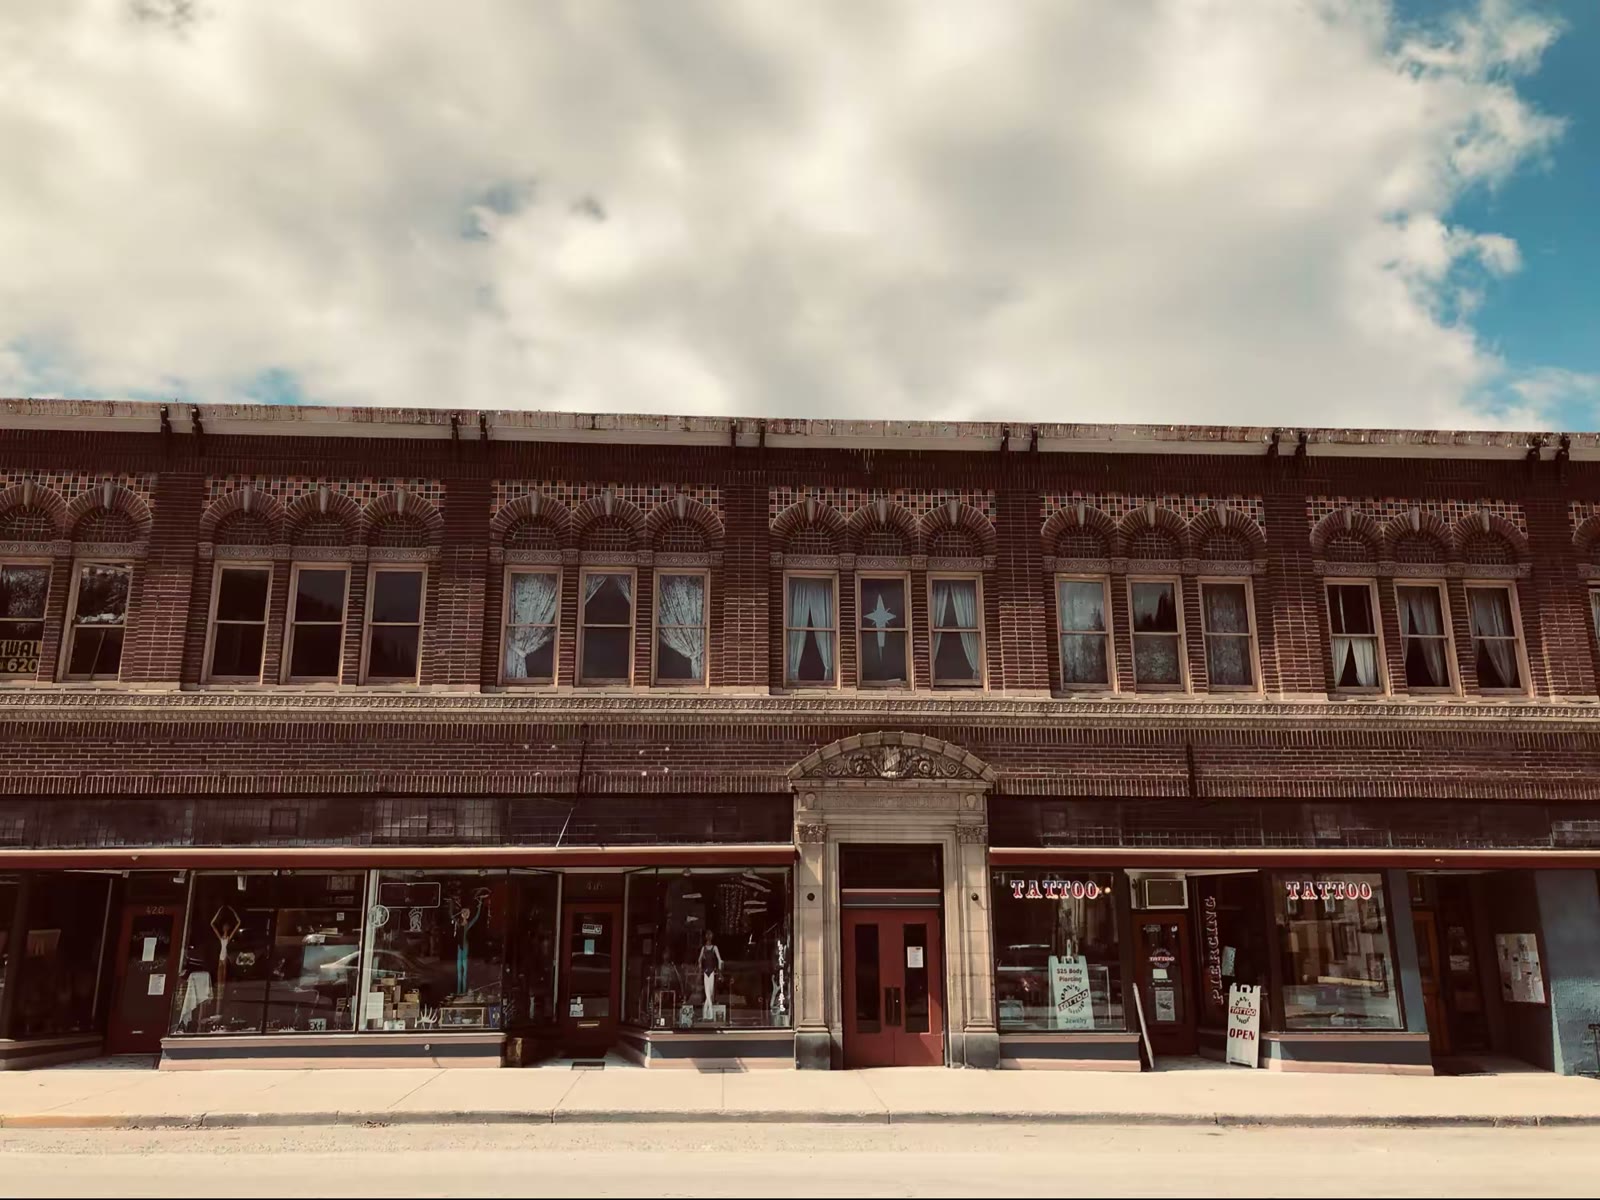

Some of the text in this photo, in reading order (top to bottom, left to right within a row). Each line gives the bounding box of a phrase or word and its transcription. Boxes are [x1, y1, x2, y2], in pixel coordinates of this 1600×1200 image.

[7, 658, 38, 672] 620
[1010, 879, 1099, 899] TATTOO
[1285, 881, 1372, 900] TATTOO
[1204, 896, 1224, 1005] PIERCING
[1058, 989, 1089, 1012] TATTOO
[1230, 1006, 1256, 1017] TATTOO
[1229, 1028, 1256, 1041] OPEN
